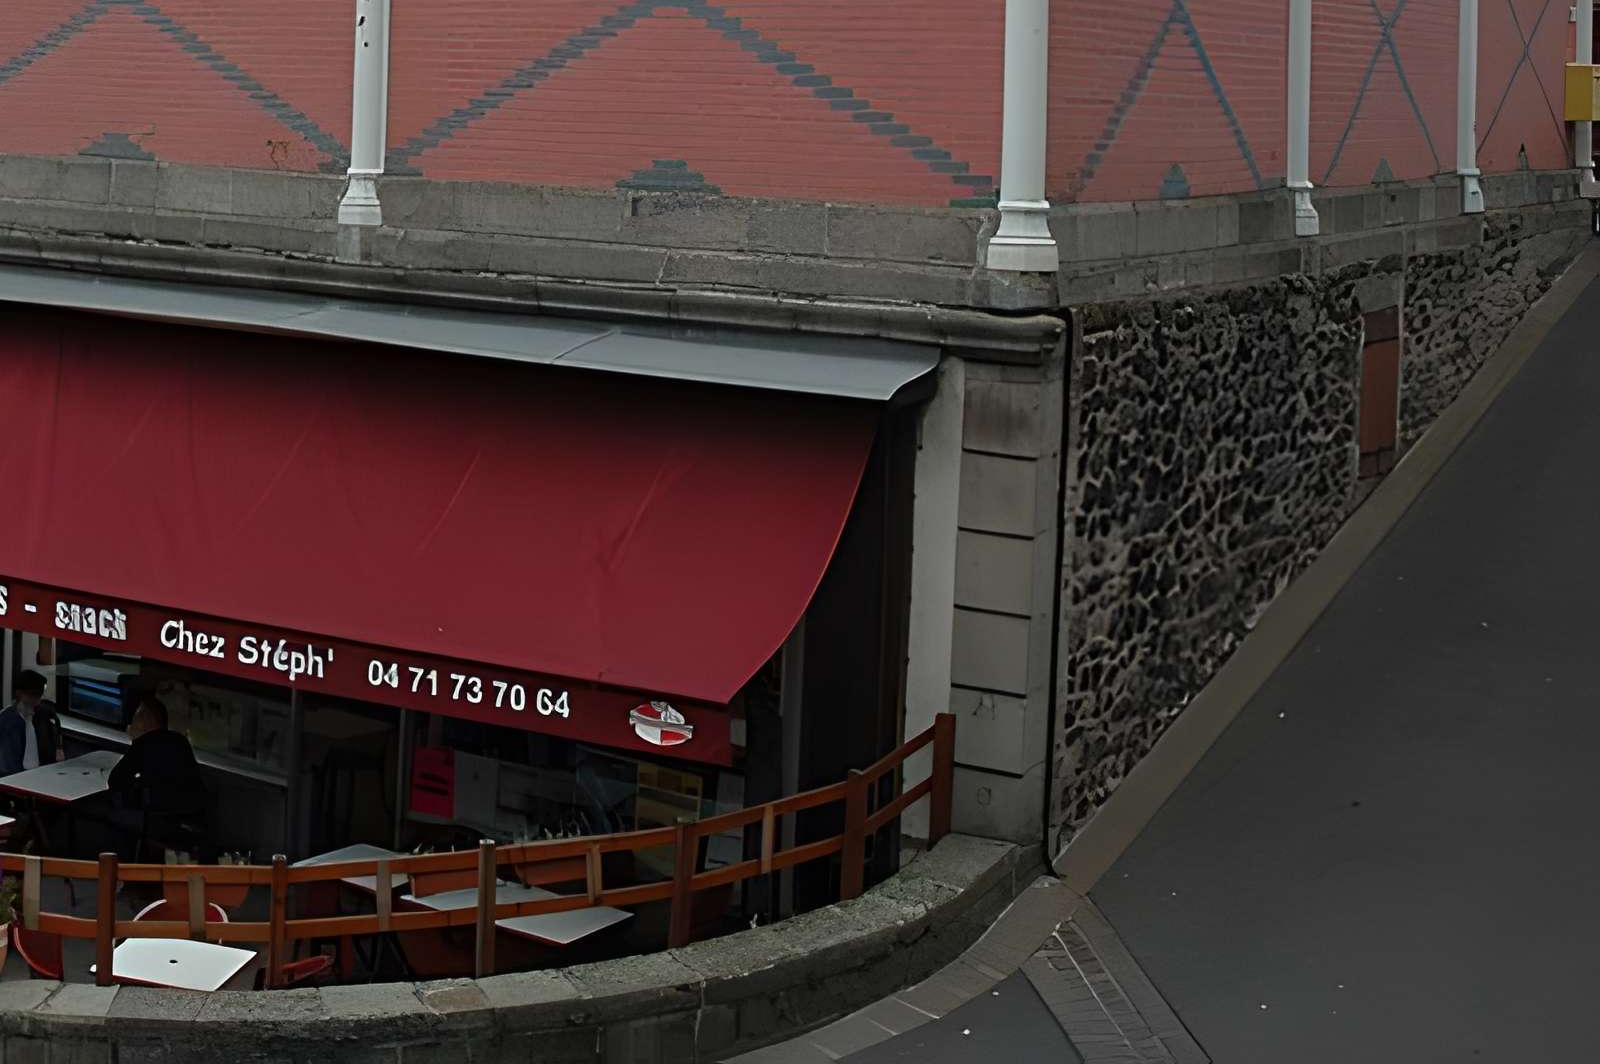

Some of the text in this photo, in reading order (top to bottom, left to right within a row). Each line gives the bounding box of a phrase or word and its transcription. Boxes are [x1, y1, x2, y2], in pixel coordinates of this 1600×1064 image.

[161, 620, 224, 658] Chez
[368, 660, 569, 717] 04 71 73 70 64
